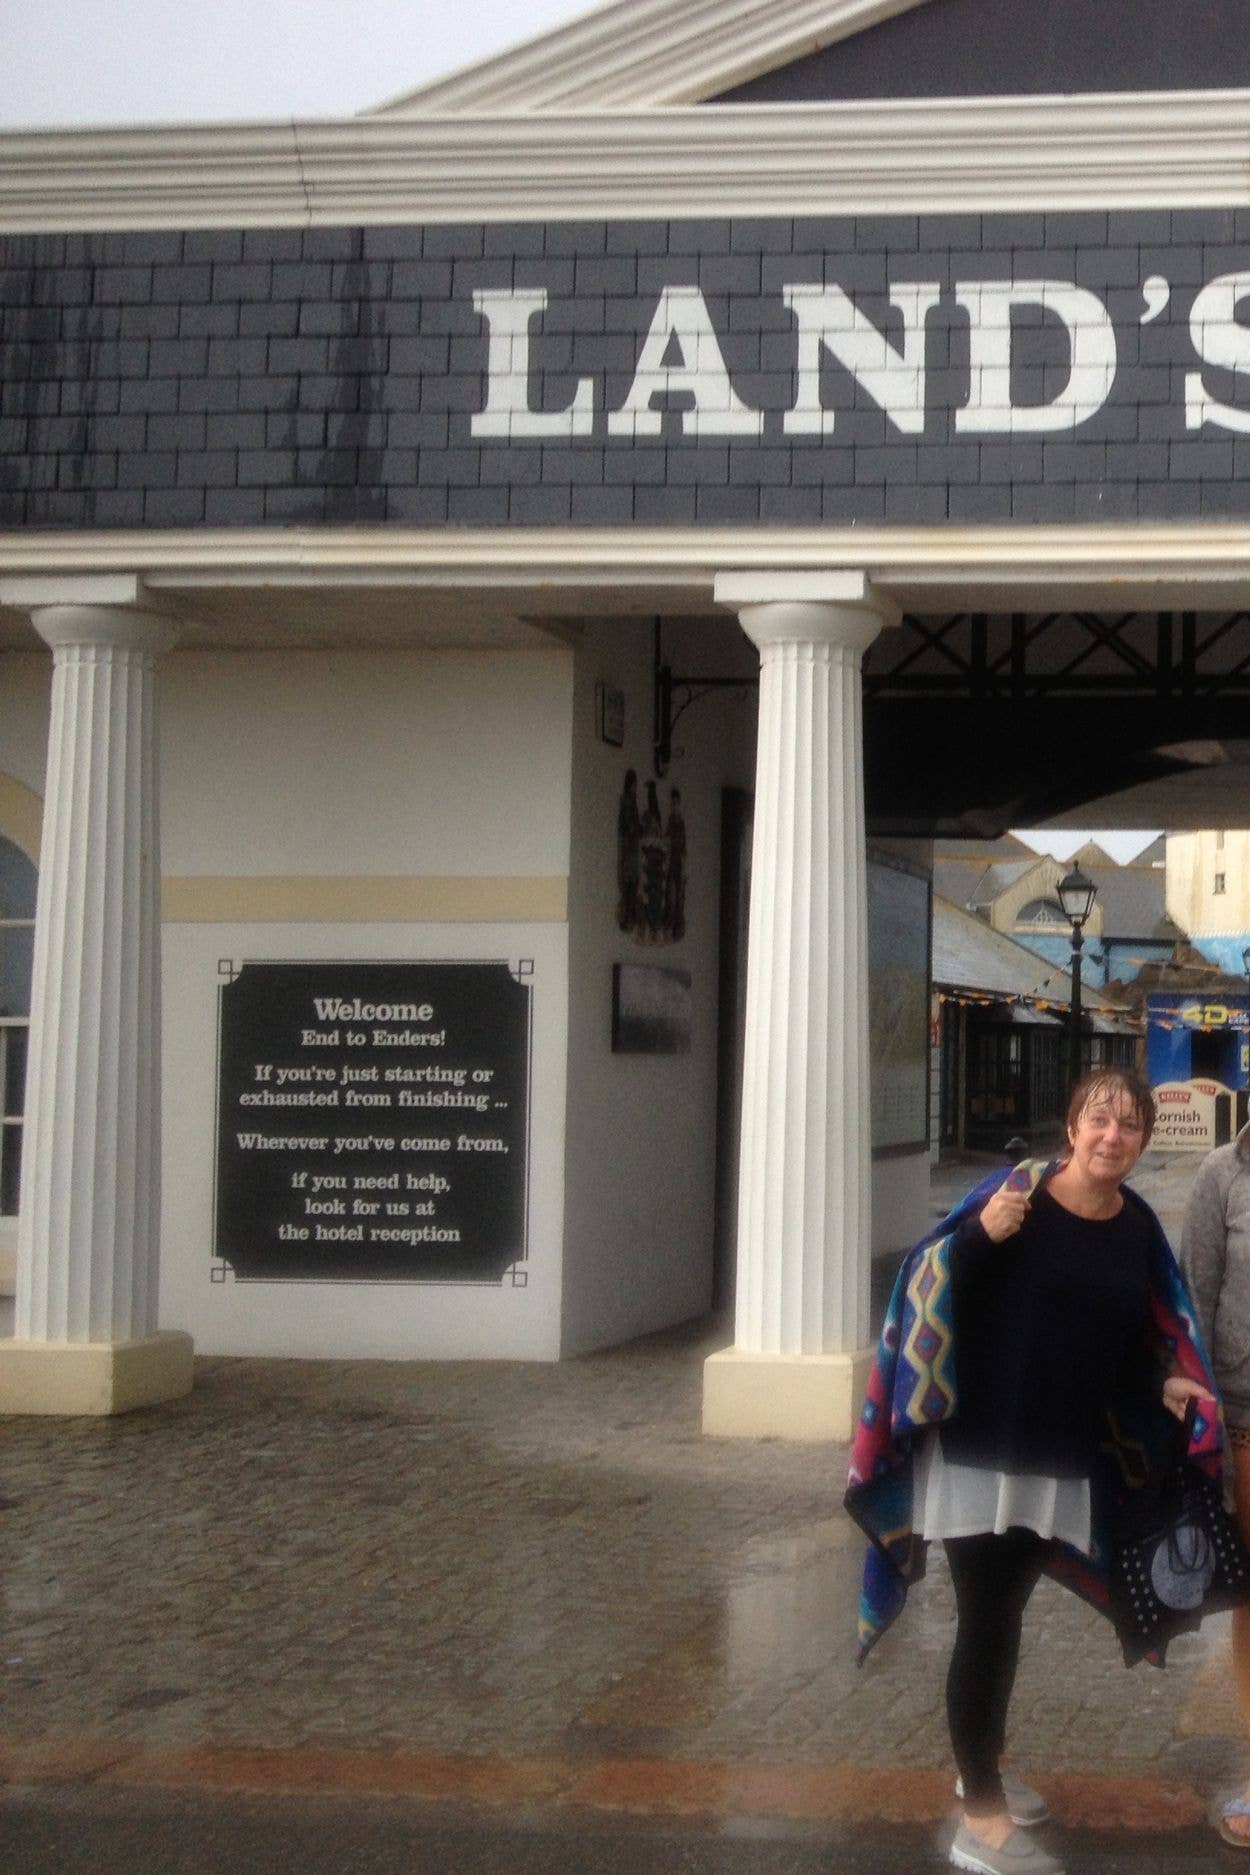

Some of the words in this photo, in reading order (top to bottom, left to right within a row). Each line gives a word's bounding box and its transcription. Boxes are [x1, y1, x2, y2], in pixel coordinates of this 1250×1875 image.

[314, 998, 433, 1021] Welcome
[301, 1030, 339, 1045] End
[346, 1031, 366, 1046] to
[373, 1030, 445, 1046] Enders!
[255, 1065, 273, 1080] If
[277, 1066, 336, 1085] you're
[340, 1066, 379, 1085] just
[385, 1066, 467, 1086] starting
[472, 1070, 493, 1082] or
[239, 1090, 339, 1106] exhausted
[345, 1090, 391, 1106] from
[398, 1090, 489, 1111] finishing
[1159, 1110, 1200, 1122] ornish
[1153, 1126, 1208, 1136] e-cream
[237, 1133, 329, 1149] Wherever
[334, 1135, 395, 1154] you've
[401, 1138, 451, 1150] come
[457, 1135, 508, 1153] from,
[292, 1172, 308, 1188] if
[312, 1176, 347, 1192] you
[354, 1174, 399, 1189] need
[407, 1174, 450, 1194] help,
[305, 1198, 345, 1215] look
[353, 1199, 380, 1215] for
[386, 1203, 409, 1215] us
[415, 1200, 435, 1215] at
[279, 1224, 309, 1240] the
[315, 1225, 363, 1240] hotel
[370, 1226, 460, 1245] reception
